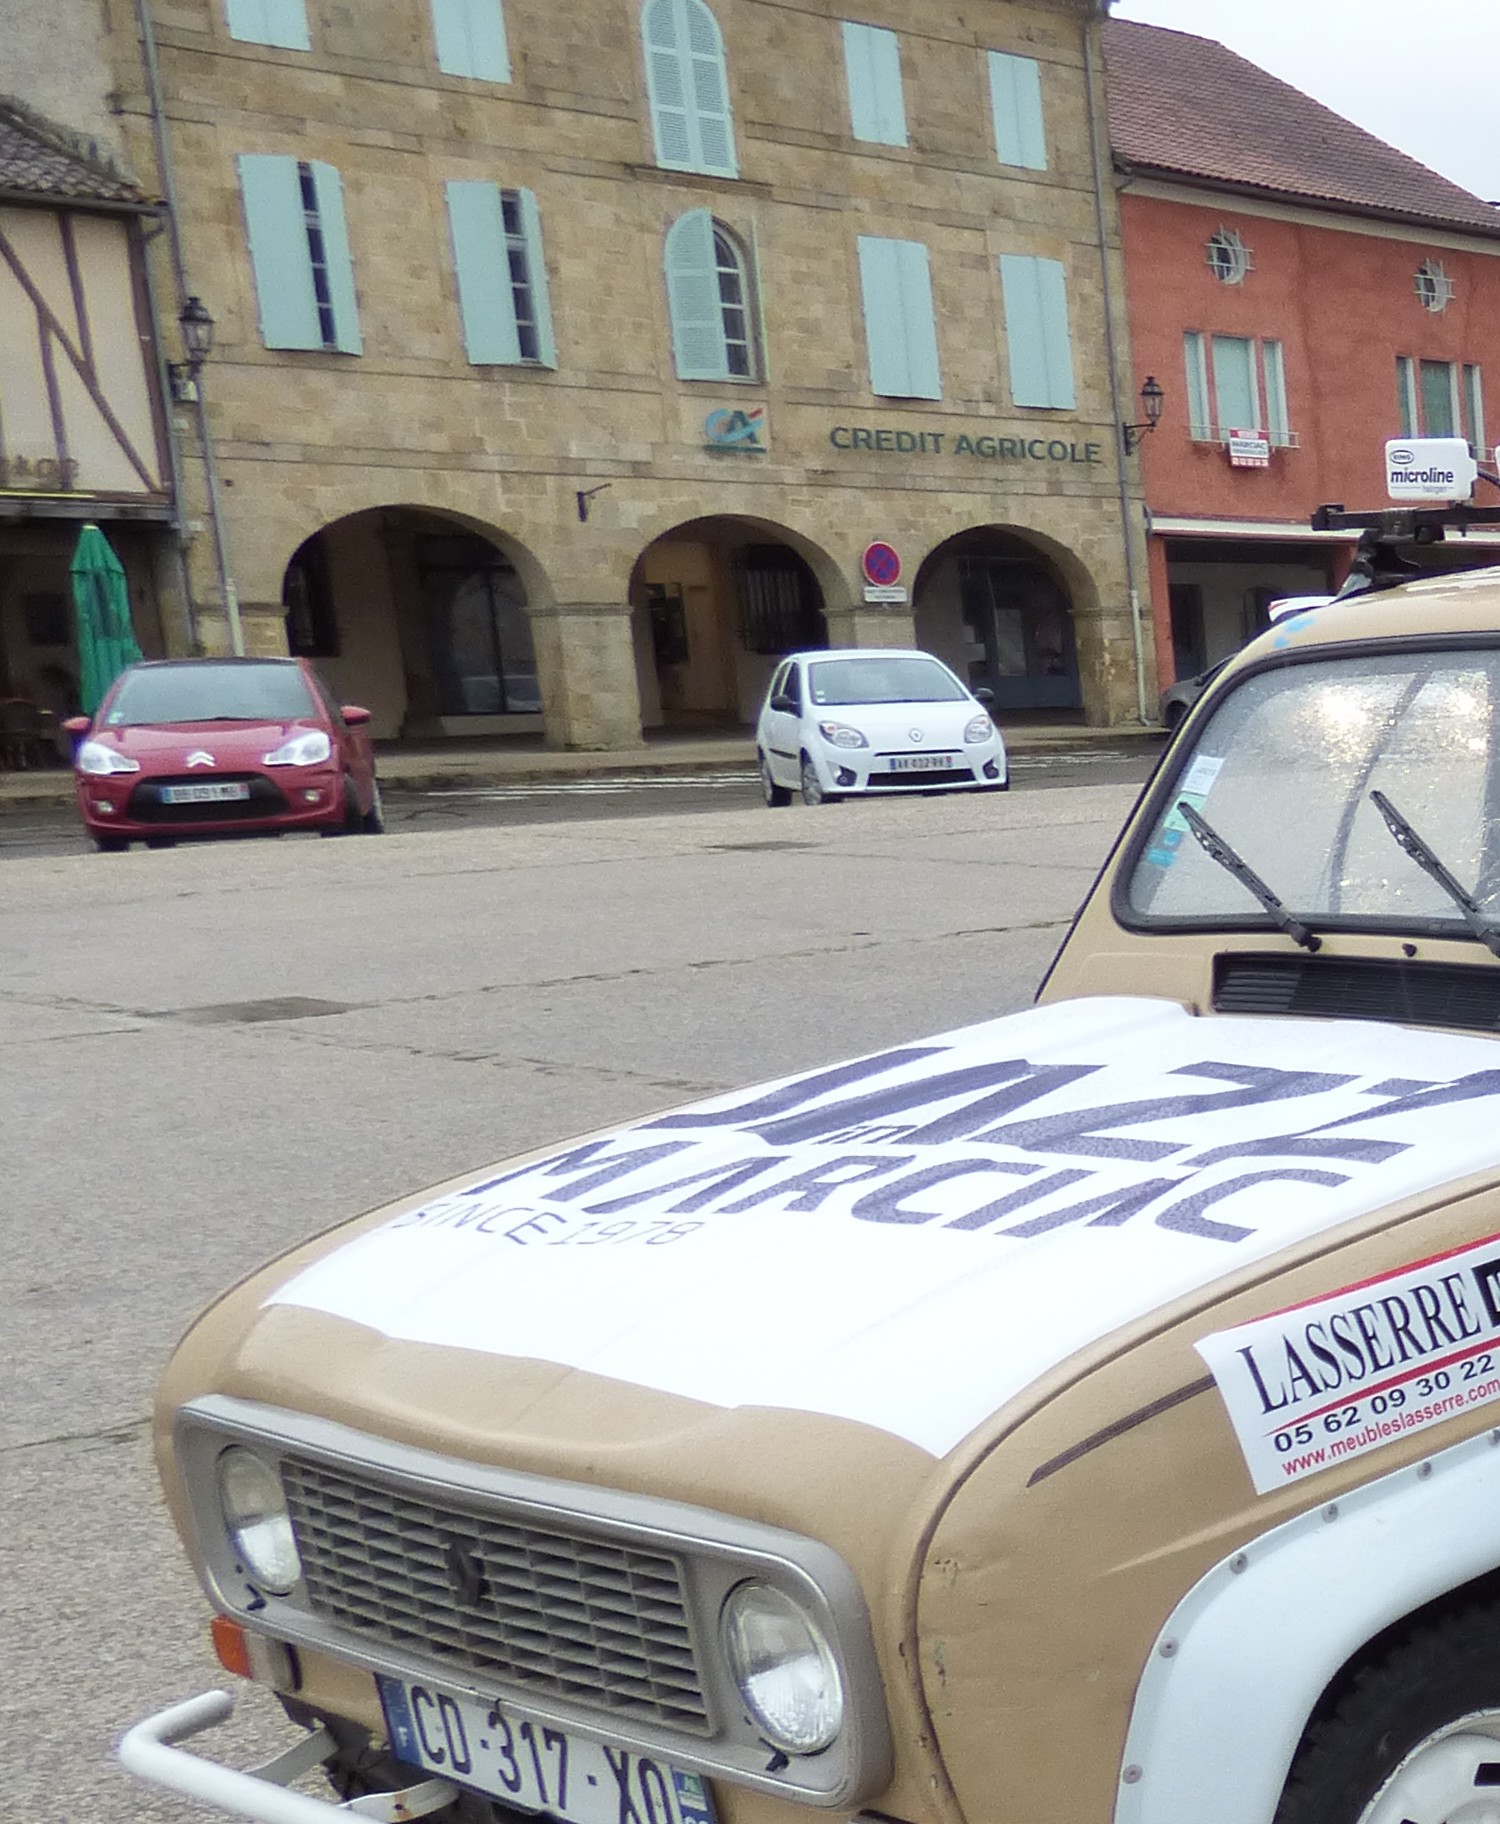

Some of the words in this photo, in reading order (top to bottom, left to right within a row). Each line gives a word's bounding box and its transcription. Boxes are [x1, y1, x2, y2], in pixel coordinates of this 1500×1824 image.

[829, 426, 945, 454] CREDIT
[954, 433, 1103, 464] AGRICOLE
[1391, 467, 1454, 483] microline
[808, 1124, 920, 1146] in
[458, 1139, 1354, 1244] MARCIAC
[392, 1202, 568, 1246] SINCE
[546, 1220, 705, 1246] 1978
[1236, 1271, 1482, 1416] LASSERRE
[1273, 1422, 1314, 1453] 05
[1323, 1406, 1362, 1434] 62
[1373, 1388, 1407, 1418] 09
[1417, 1370, 1452, 1399] 30
[1461, 1353, 1496, 1383] 22
